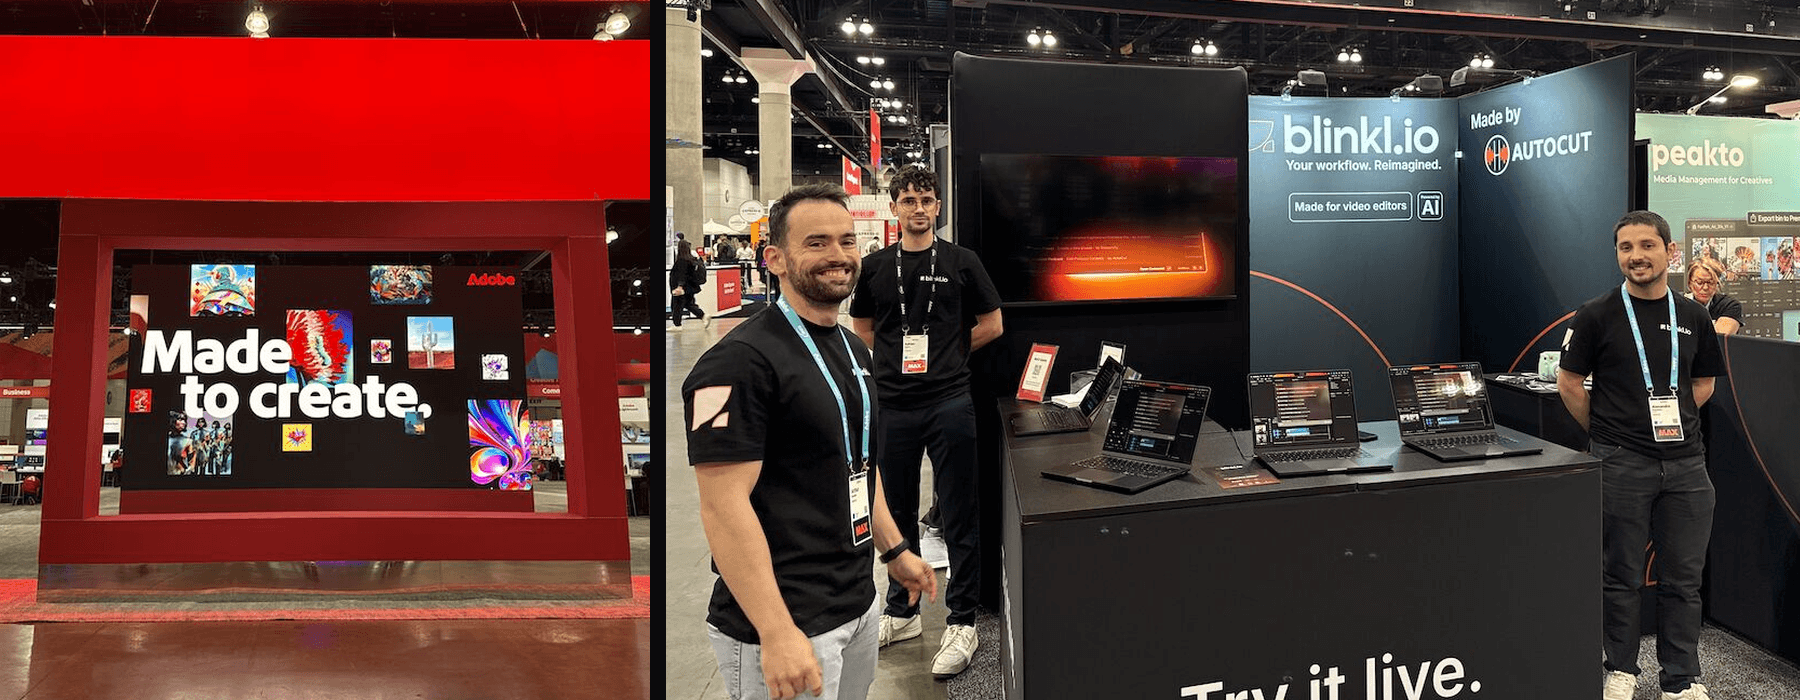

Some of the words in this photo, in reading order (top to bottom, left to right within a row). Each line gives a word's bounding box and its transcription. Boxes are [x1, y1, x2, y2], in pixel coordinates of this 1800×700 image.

[1471, 110, 1503, 129] Made
[1505, 107, 1521, 126] by
[1283, 114, 1439, 155] blinkl.io
[1511, 130, 1592, 162] AUTOCUT
[1652, 139, 1744, 172] peakto
[1286, 159, 1313, 171] Your
[1315, 160, 1371, 171] workflow.
[1374, 159, 1442, 173] Reimagined.
[1653, 175, 1676, 184] Media
[1678, 176, 1727, 186] Management
[1728, 176, 1738, 184] for
[1739, 176, 1773, 184] Creatives
[1294, 201, 1324, 212] Made
[1325, 201, 1341, 212] for
[1343, 201, 1371, 212] video
[1372, 200, 1408, 211] editors
[1421, 200, 1440, 216] AI
[1758, 214, 1775, 222] Export
[467, 273, 515, 286] Adobe
[140, 328, 293, 374] Made
[180, 375, 240, 419] to
[249, 374, 432, 419] create.
[1658, 428, 1678, 436] MAX
[1309, 664, 1346, 700] it
[1366, 652, 1482, 700] live.
